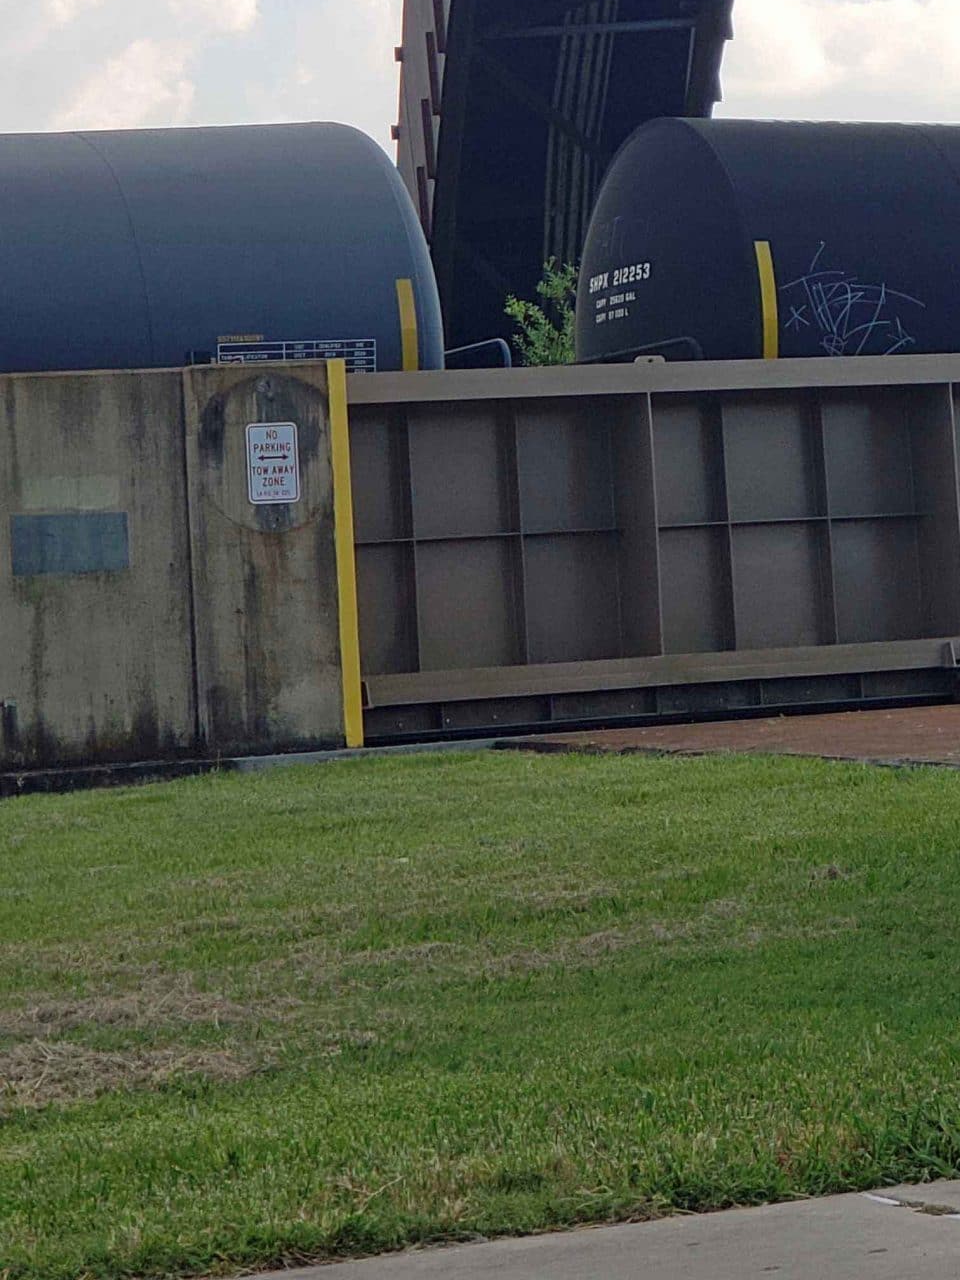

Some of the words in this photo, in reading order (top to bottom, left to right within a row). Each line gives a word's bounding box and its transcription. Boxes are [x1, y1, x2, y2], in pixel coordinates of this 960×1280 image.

[589, 272, 609, 293] SHPX
[613, 263, 650, 285] 212253
[266, 430, 278, 439] NO
[253, 442, 291, 453] PARKING
[252, 466, 269, 476] TOW
[272, 464, 295, 475] AWAY
[262, 476, 286, 487] ZONE
